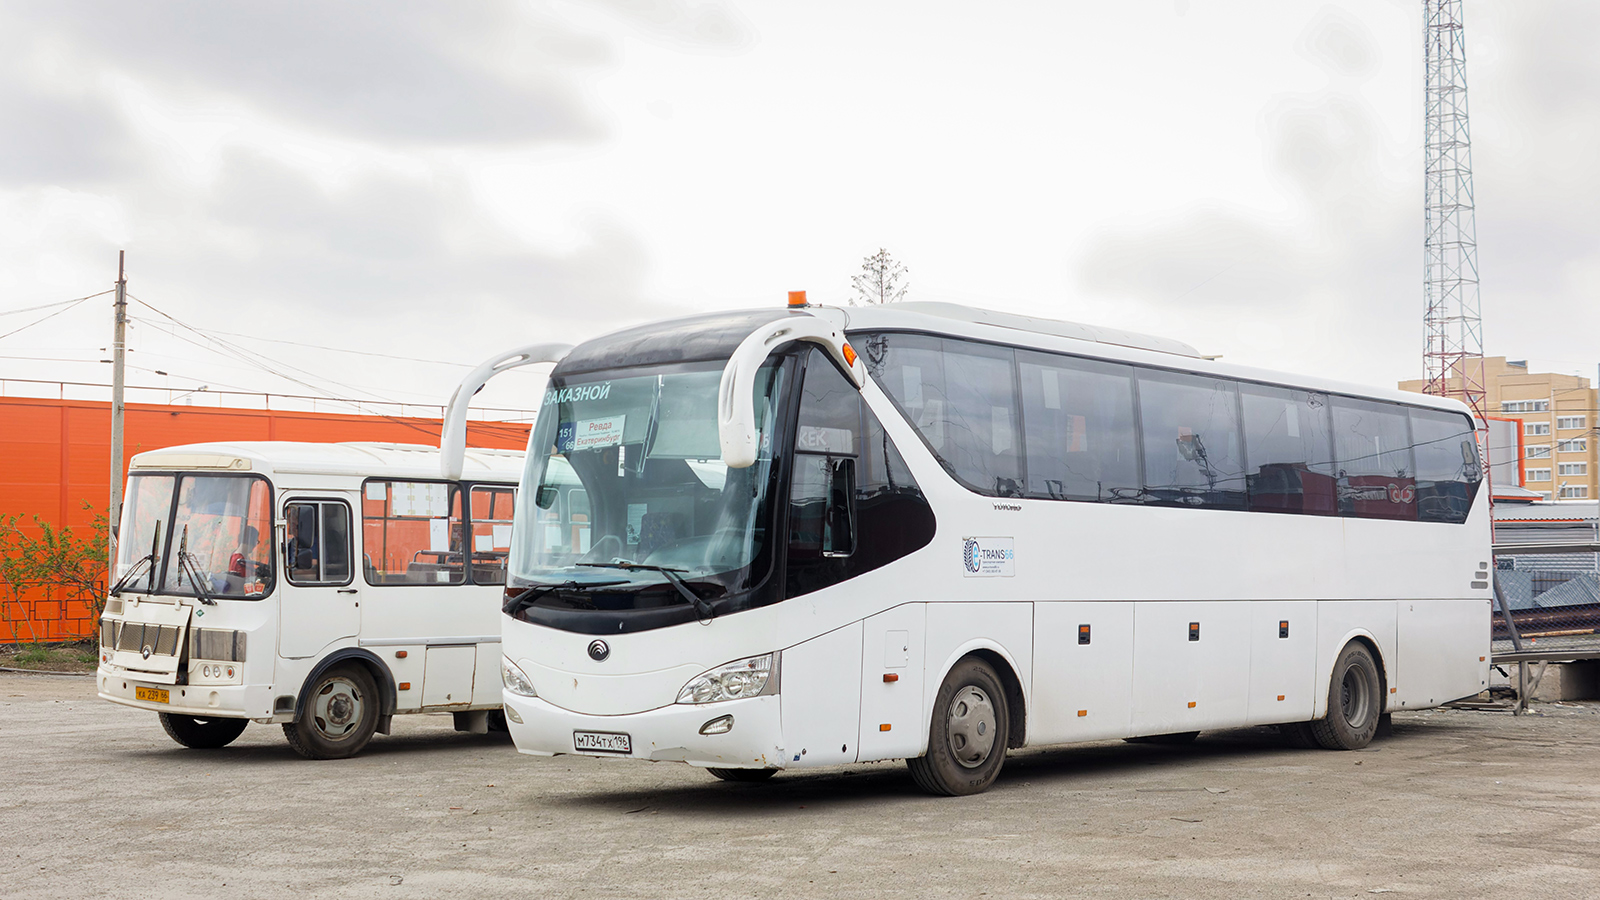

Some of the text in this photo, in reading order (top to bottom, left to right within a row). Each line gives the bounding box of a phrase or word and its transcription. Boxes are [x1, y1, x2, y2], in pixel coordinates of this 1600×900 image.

[544, 381, 612, 406] ЗАКАЗНОЙ
[589, 421, 612, 431] Ревда
[559, 427, 573, 438] 151
[565, 441, 575, 450] 66
[577, 434, 620, 446] Екатеринбург
[147, 690, 158, 700] 239
[577, 735, 628, 748] М734ТХ 196
